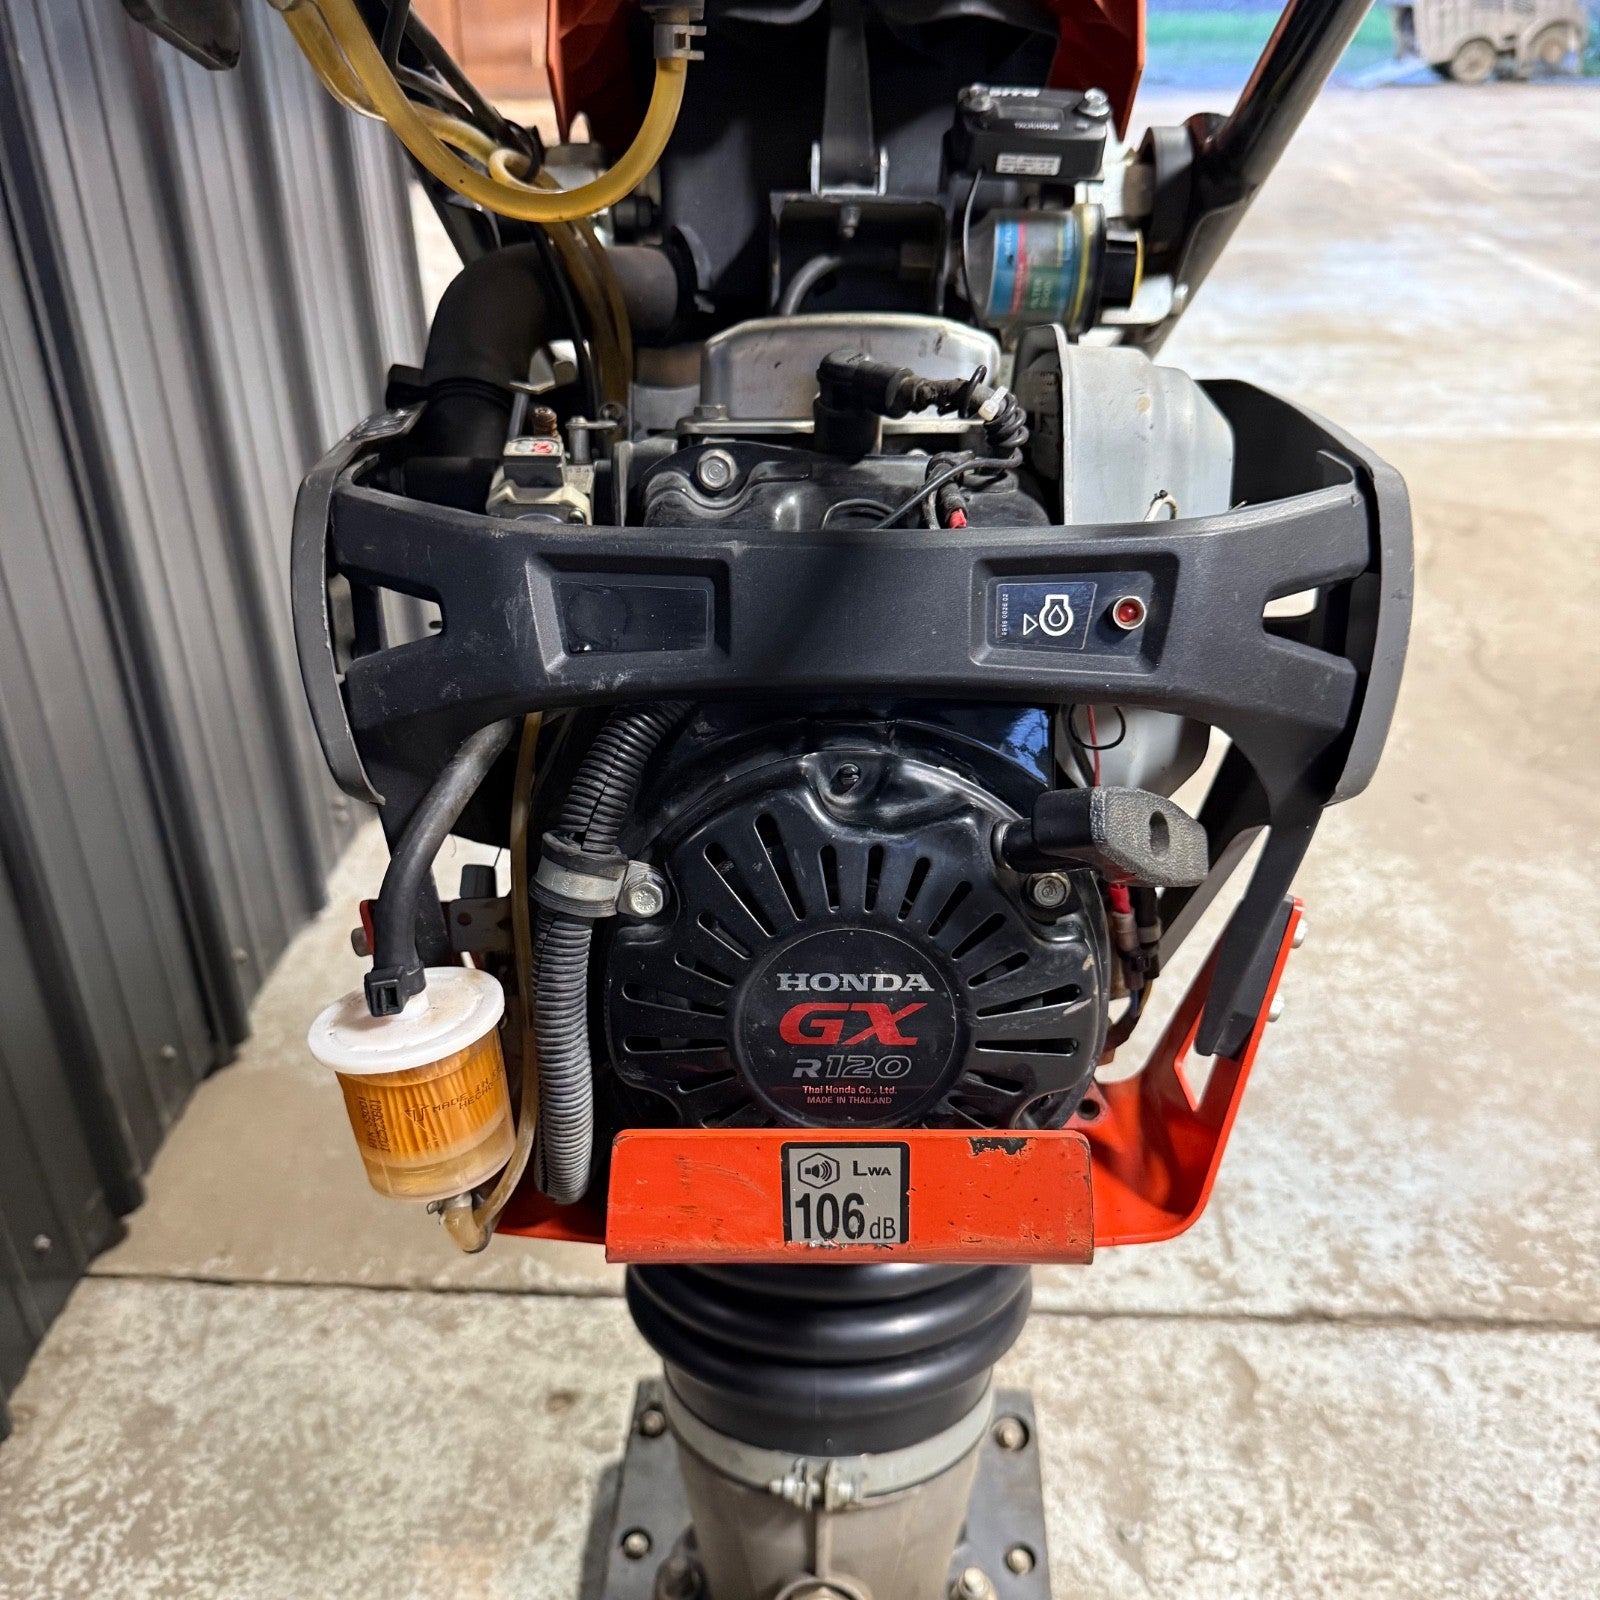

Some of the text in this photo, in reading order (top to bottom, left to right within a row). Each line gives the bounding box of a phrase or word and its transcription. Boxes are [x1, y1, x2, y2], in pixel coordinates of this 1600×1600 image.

[777, 973, 935, 992] HONDA
[779, 1002, 928, 1046] GX
[792, 1054, 912, 1079] R120
[432, 1077, 489, 1113] MADE IN
[802, 1085, 898, 1096] Thai Honda Co., Ltd.
[806, 1096, 892, 1104] MADE IN THAILAND
[795, 1192, 896, 1240] 106 dB
